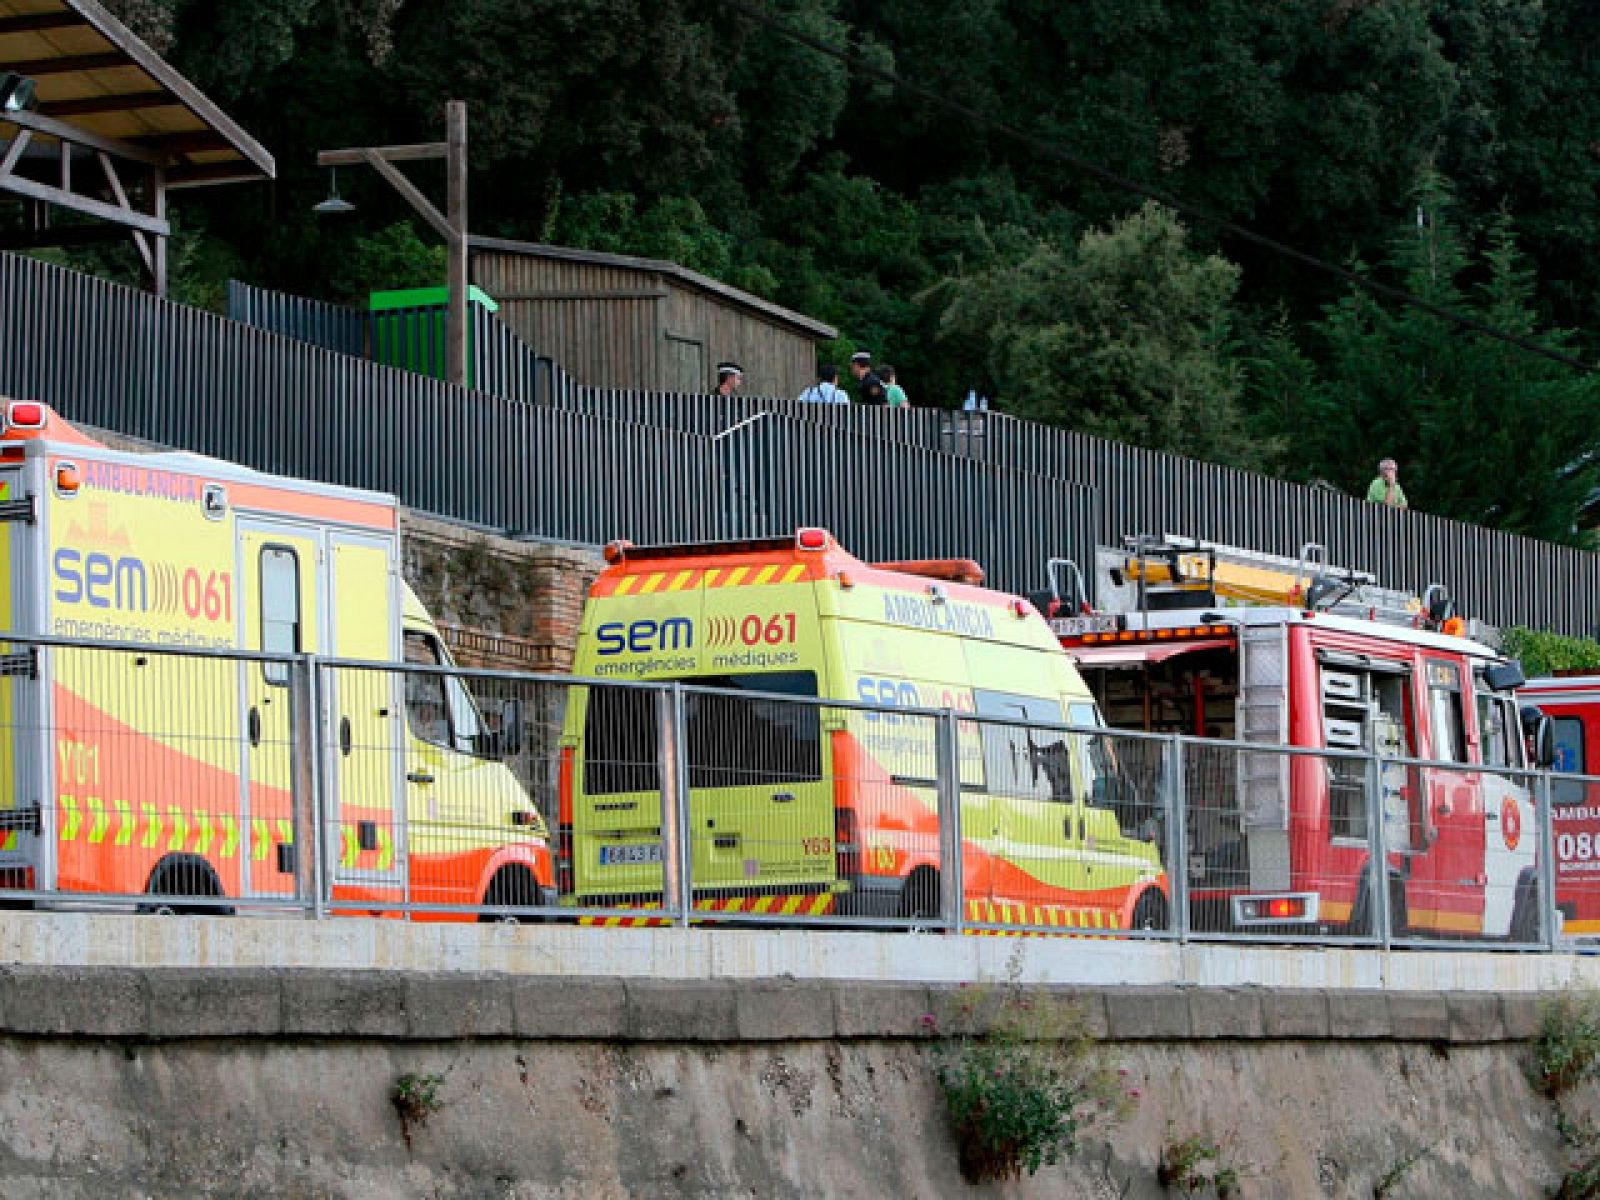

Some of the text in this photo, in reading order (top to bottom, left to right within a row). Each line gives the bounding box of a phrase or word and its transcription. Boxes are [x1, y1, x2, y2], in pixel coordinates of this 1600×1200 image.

[182, 567, 231, 622] 061
[597, 613, 797, 655] sem 061
